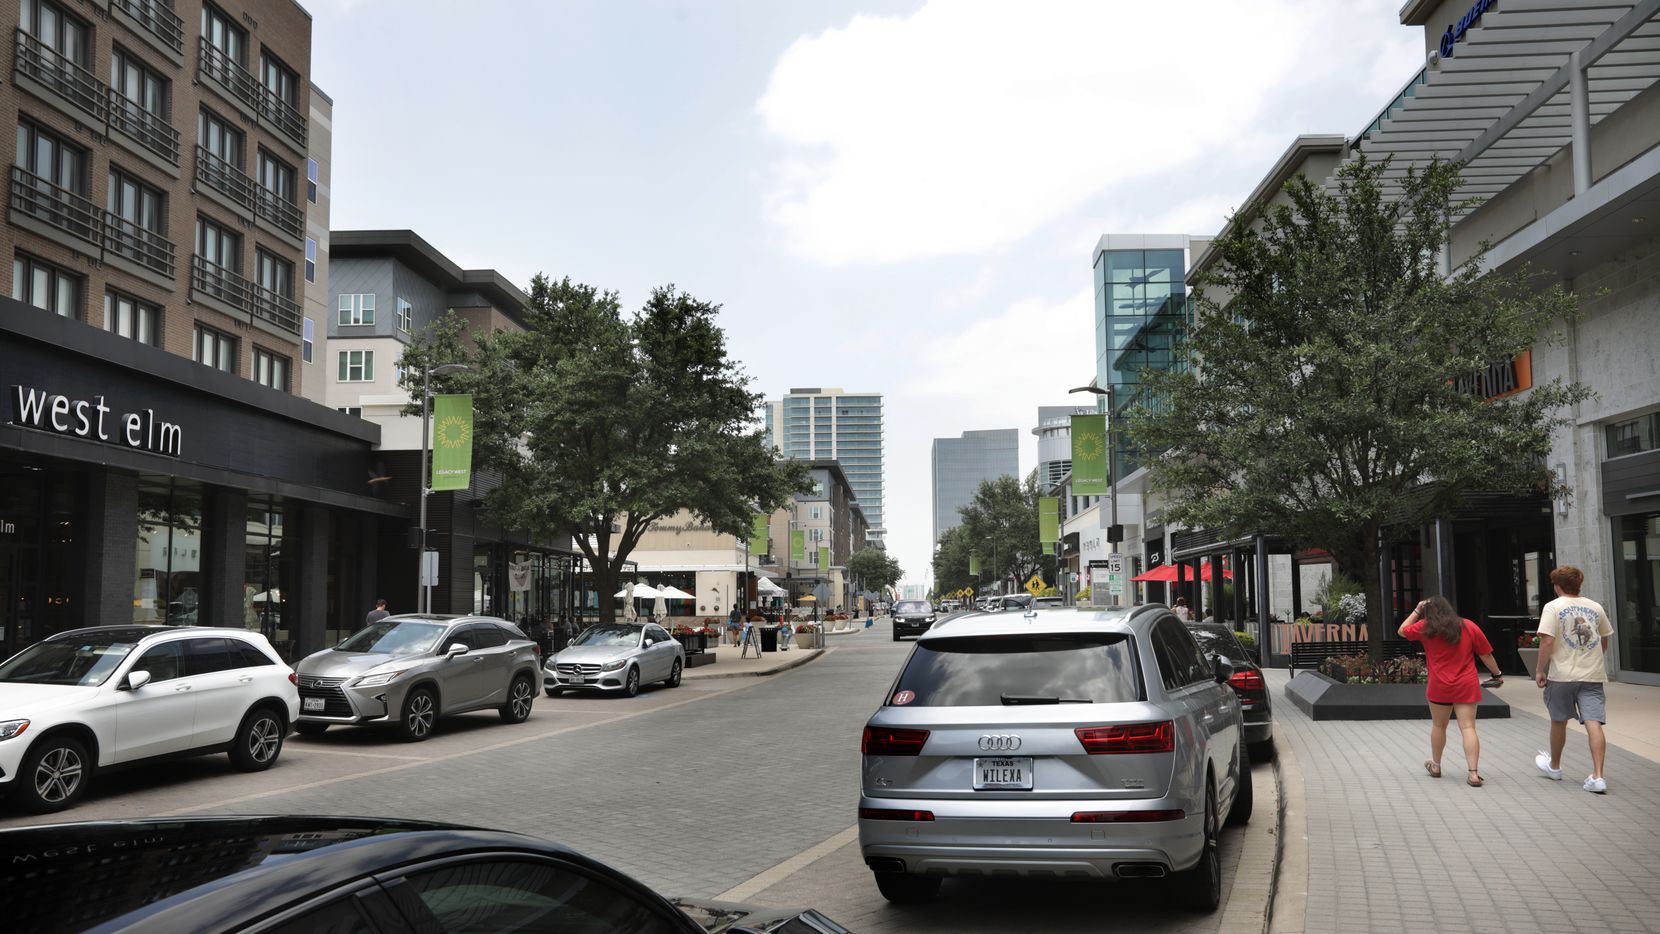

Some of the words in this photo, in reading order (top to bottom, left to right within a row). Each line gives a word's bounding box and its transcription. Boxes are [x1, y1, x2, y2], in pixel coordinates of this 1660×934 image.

[17, 385, 110, 440] west
[125, 408, 182, 455] elm
[0, 519, 15, 533] lm
[1110, 563, 1121, 572] 15
[897, 693, 909, 703] H
[983, 769, 1022, 782] WILEXA
